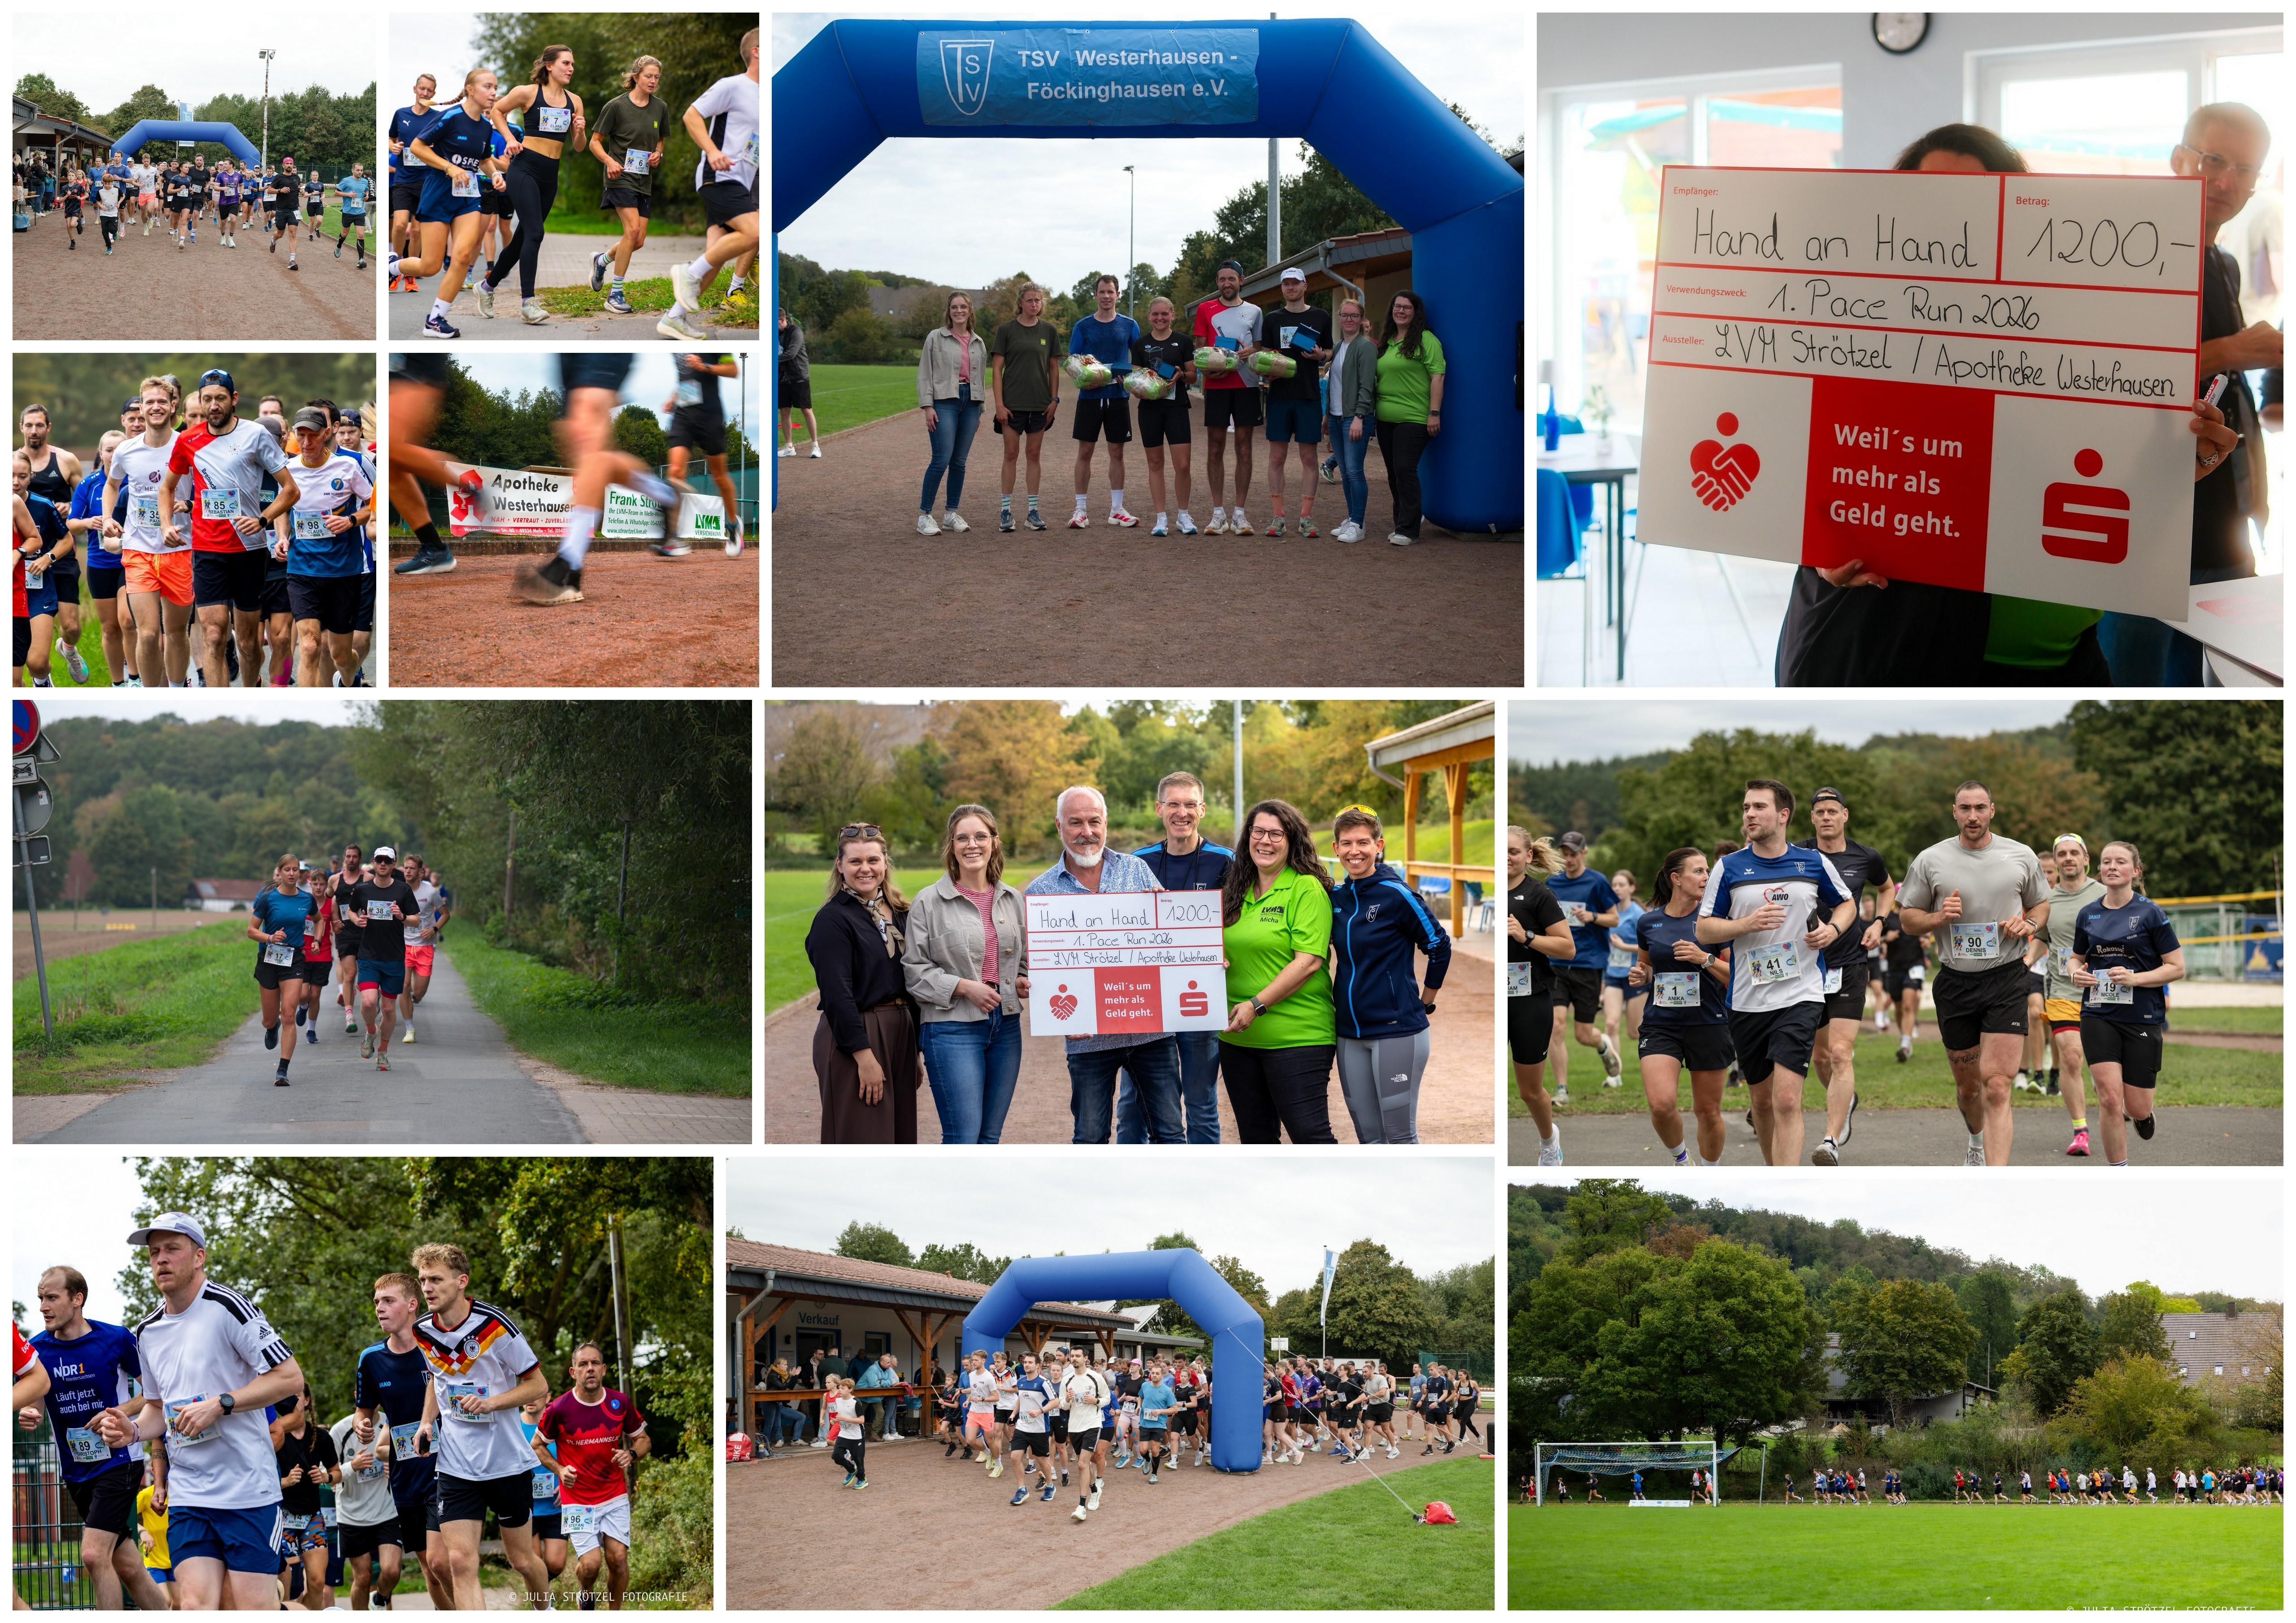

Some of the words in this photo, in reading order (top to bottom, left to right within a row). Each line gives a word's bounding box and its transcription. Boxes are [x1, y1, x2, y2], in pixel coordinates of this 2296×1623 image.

[1018, 50, 1060, 67] TSV
[1076, 49, 1224, 67] Westerhausen
[1028, 82, 1185, 103] Föckinghausen
[1192, 79, 1228, 96] e.V.
[1673, 186, 1718, 197] Empfänger:
[2016, 196, 2050, 208] Betrag:
[1694, 208, 1784, 260] Hand
[1805, 236, 1848, 261] an
[1876, 214, 1978, 268] Hand
[1666, 284, 1747, 298] Verwendungszweck:
[1768, 283, 1795, 312] 1.
[1805, 279, 1888, 319] Pace
[1903, 286, 1963, 324] Run
[1972, 295, 2040, 330] 2026
[1662, 334, 1705, 345] Aussteller:
[1791, 330, 1892, 369] Strötzel
[1935, 343, 2045, 386] Apotheke
[2057, 354, 2175, 398] Westerhausen
[1923, 438, 1962, 458] um
[491, 474, 558, 493] Apotheke
[1832, 464, 1898, 490] mehr
[1904, 470, 1940, 495] als
[214, 501, 225, 510] 85
[610, 491, 637, 506] Frank
[149, 511, 160, 519] 35
[695, 513, 713, 529] LVM
[1830, 500, 1885, 527] Geld
[1893, 511, 1960, 538] geht.
[308, 521, 319, 529] 98
[1040, 910, 1078, 928] Hand
[1086, 918, 1103, 927] an
[1112, 908, 1150, 925] Hand
[1074, 935, 1084, 946] 1.
[1087, 933, 1120, 946] Pace
[1124, 932, 1146, 944] Run
[1149, 932, 1173, 945] 2026
[1968, 937, 1981, 947] 90
[1084, 950, 1123, 963] Strötzel
[1138, 951, 1176, 965] Apotheke
[1179, 951, 1218, 963] Westerhausen
[1766, 958, 1780, 970] 41
[1672, 986, 1677, 996] 1
[2104, 982, 2116, 992] 19
[1131, 995, 1144, 1003] als
[1105, 1009, 1126, 1018] Geld
[1129, 1008, 1153, 1019] geht.
[798, 1312, 839, 1326] Verkauf
[259, 1330, 272, 1340] adidas
[53, 1361, 78, 1380] NDR
[78, 1363, 85, 1374] 1
[65, 1373, 96, 1382] Niedersachsen
[55, 1389, 76, 1402] Läuft
[77, 1388, 96, 1401] jetzt
[60, 1405, 76, 1414] auch
[78, 1403, 90, 1412] bei
[91, 1399, 104, 1409] mir.
[79, 1441, 91, 1452] 89
[732, 1445, 742, 1461] BIKE
